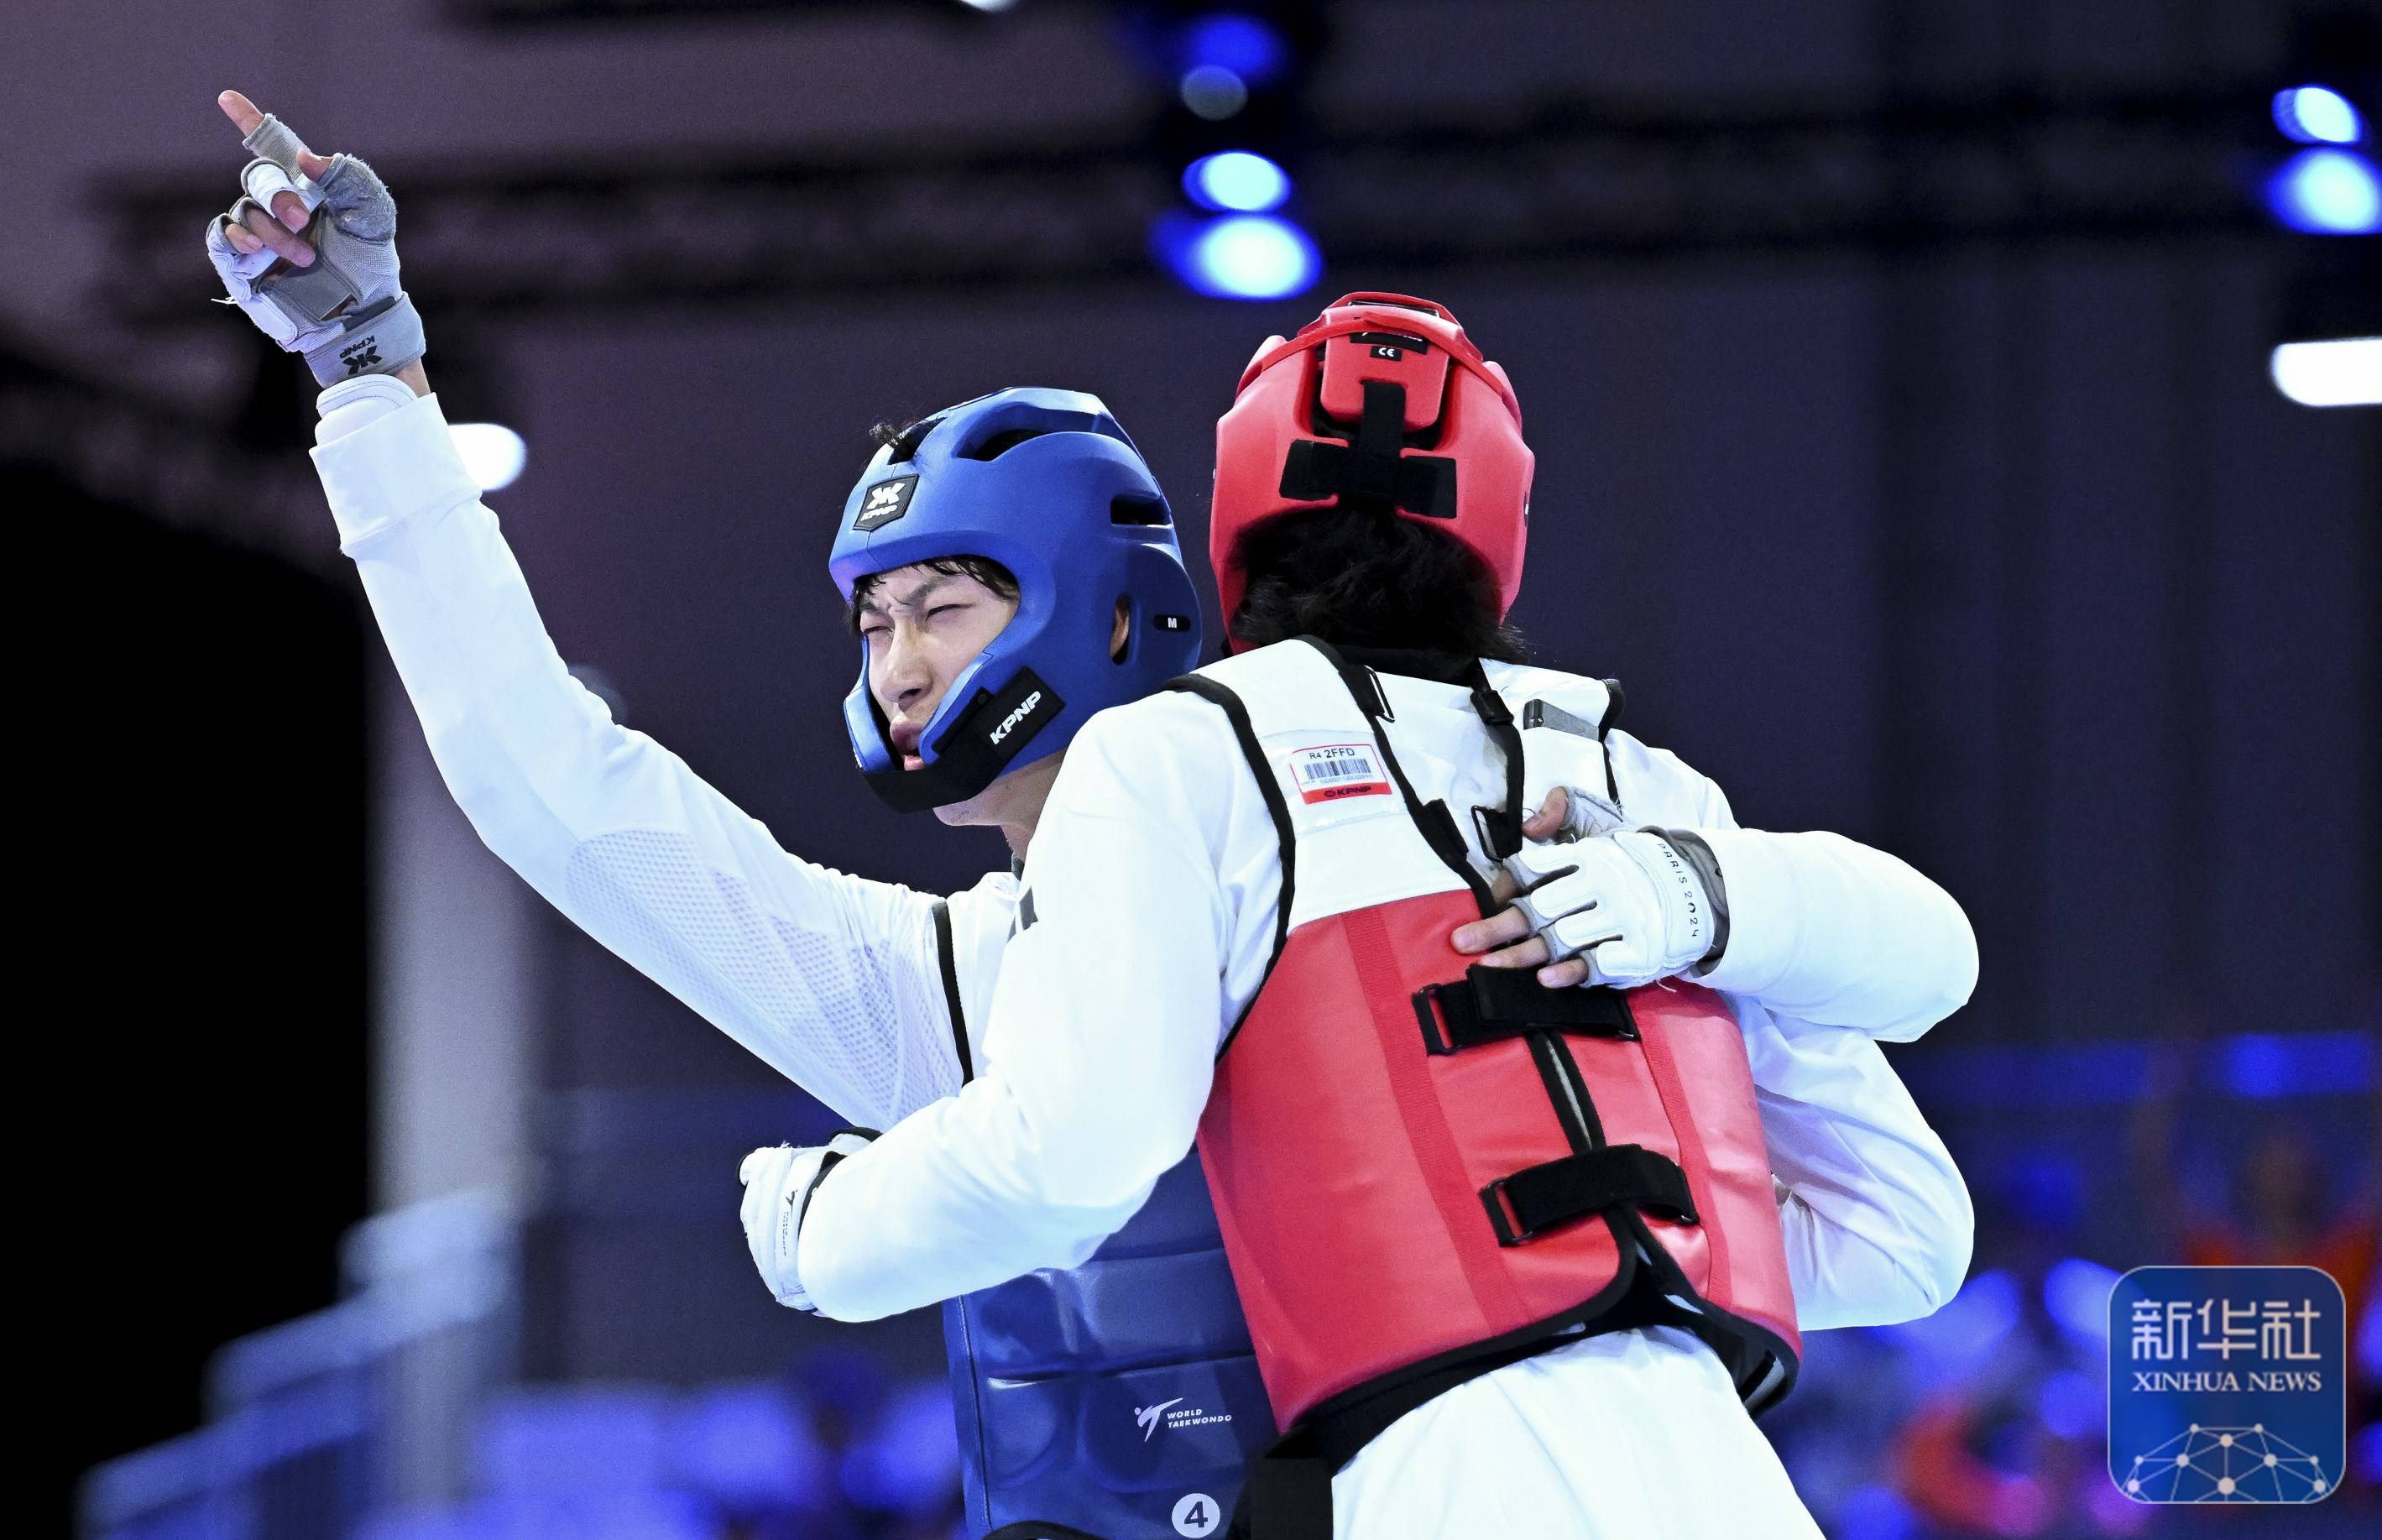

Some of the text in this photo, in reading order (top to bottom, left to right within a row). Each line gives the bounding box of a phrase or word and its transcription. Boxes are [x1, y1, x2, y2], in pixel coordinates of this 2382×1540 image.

[339, 335, 375, 358] KPNP
[1167, 617, 1178, 629] M
[990, 691, 1042, 745] KPNP
[1324, 748, 1356, 759] 2FFD
[1658, 842, 1700, 937] PARIS 2024
[1167, 1408, 1202, 1419] WORLD
[1167, 1414, 1232, 1428] TAEKWONDO
[1183, 1501, 1209, 1528] 4
